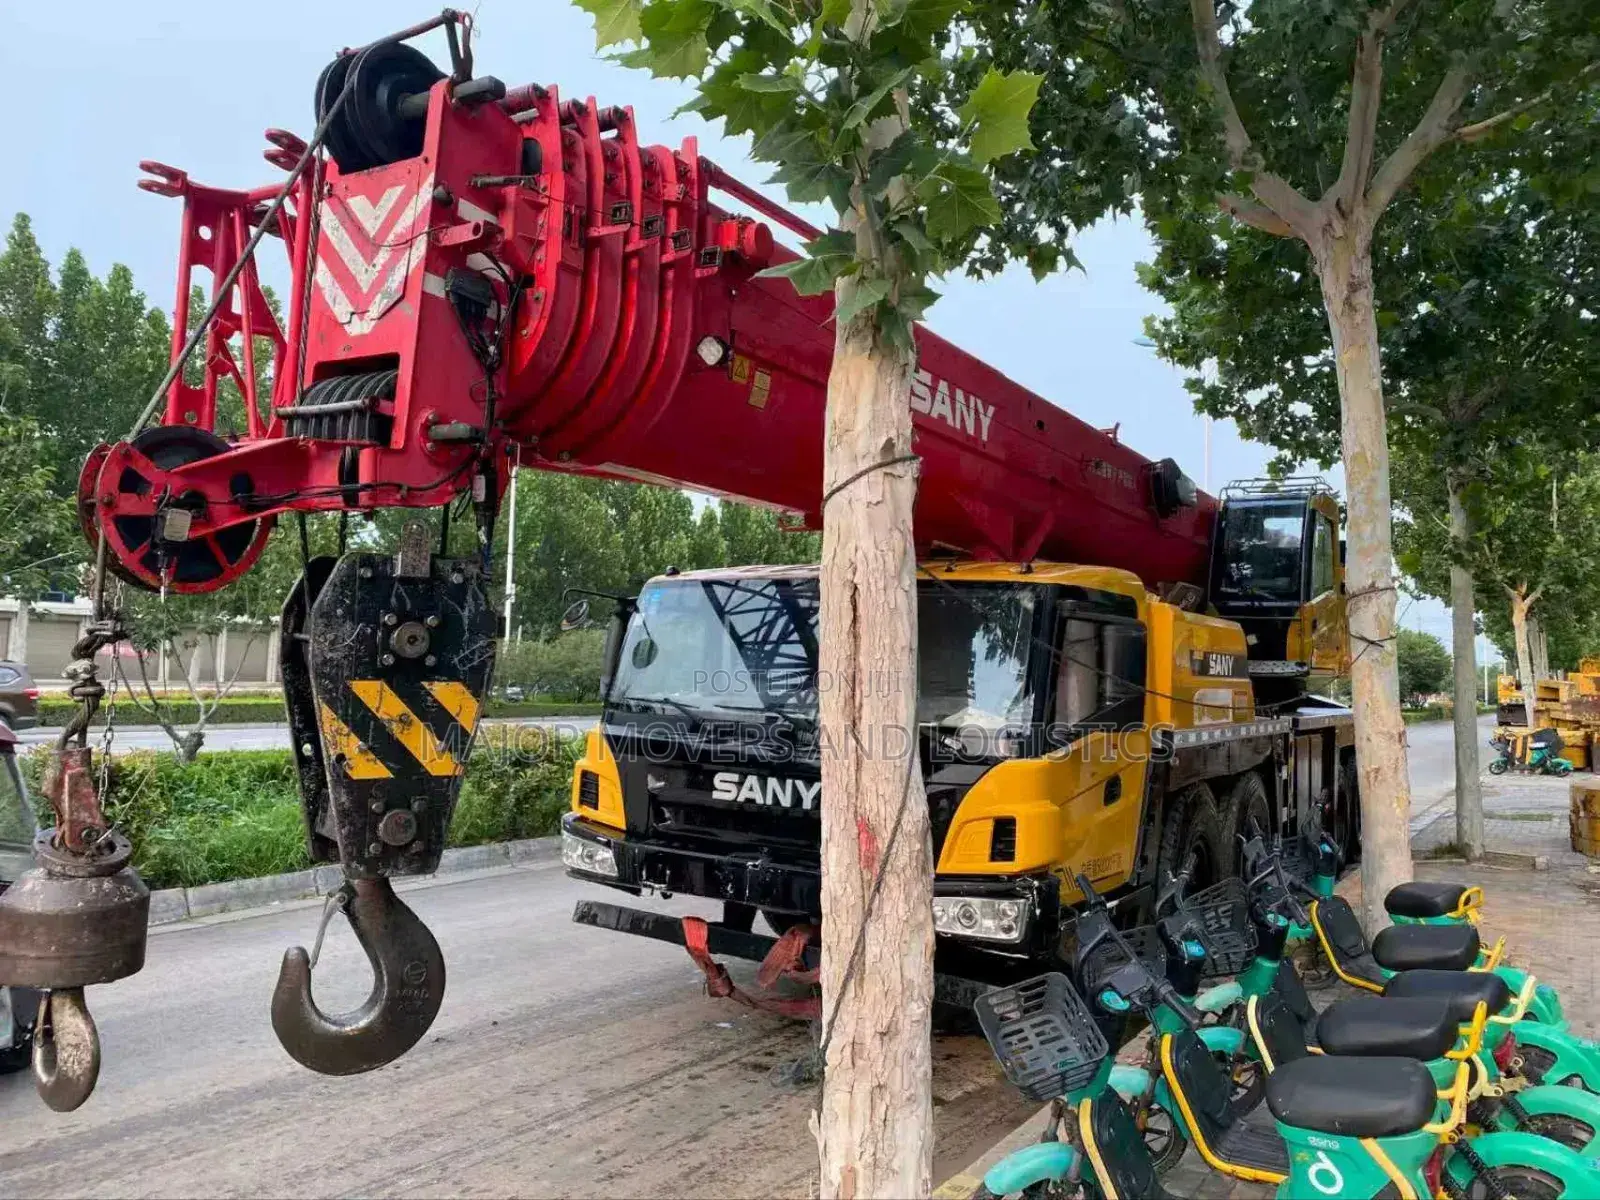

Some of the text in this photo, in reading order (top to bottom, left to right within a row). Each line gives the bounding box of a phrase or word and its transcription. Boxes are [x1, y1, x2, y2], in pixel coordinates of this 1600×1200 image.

[910, 368, 995, 442] SANY
[1208, 653, 1235, 676] SANY
[711, 771, 822, 810] SANY
